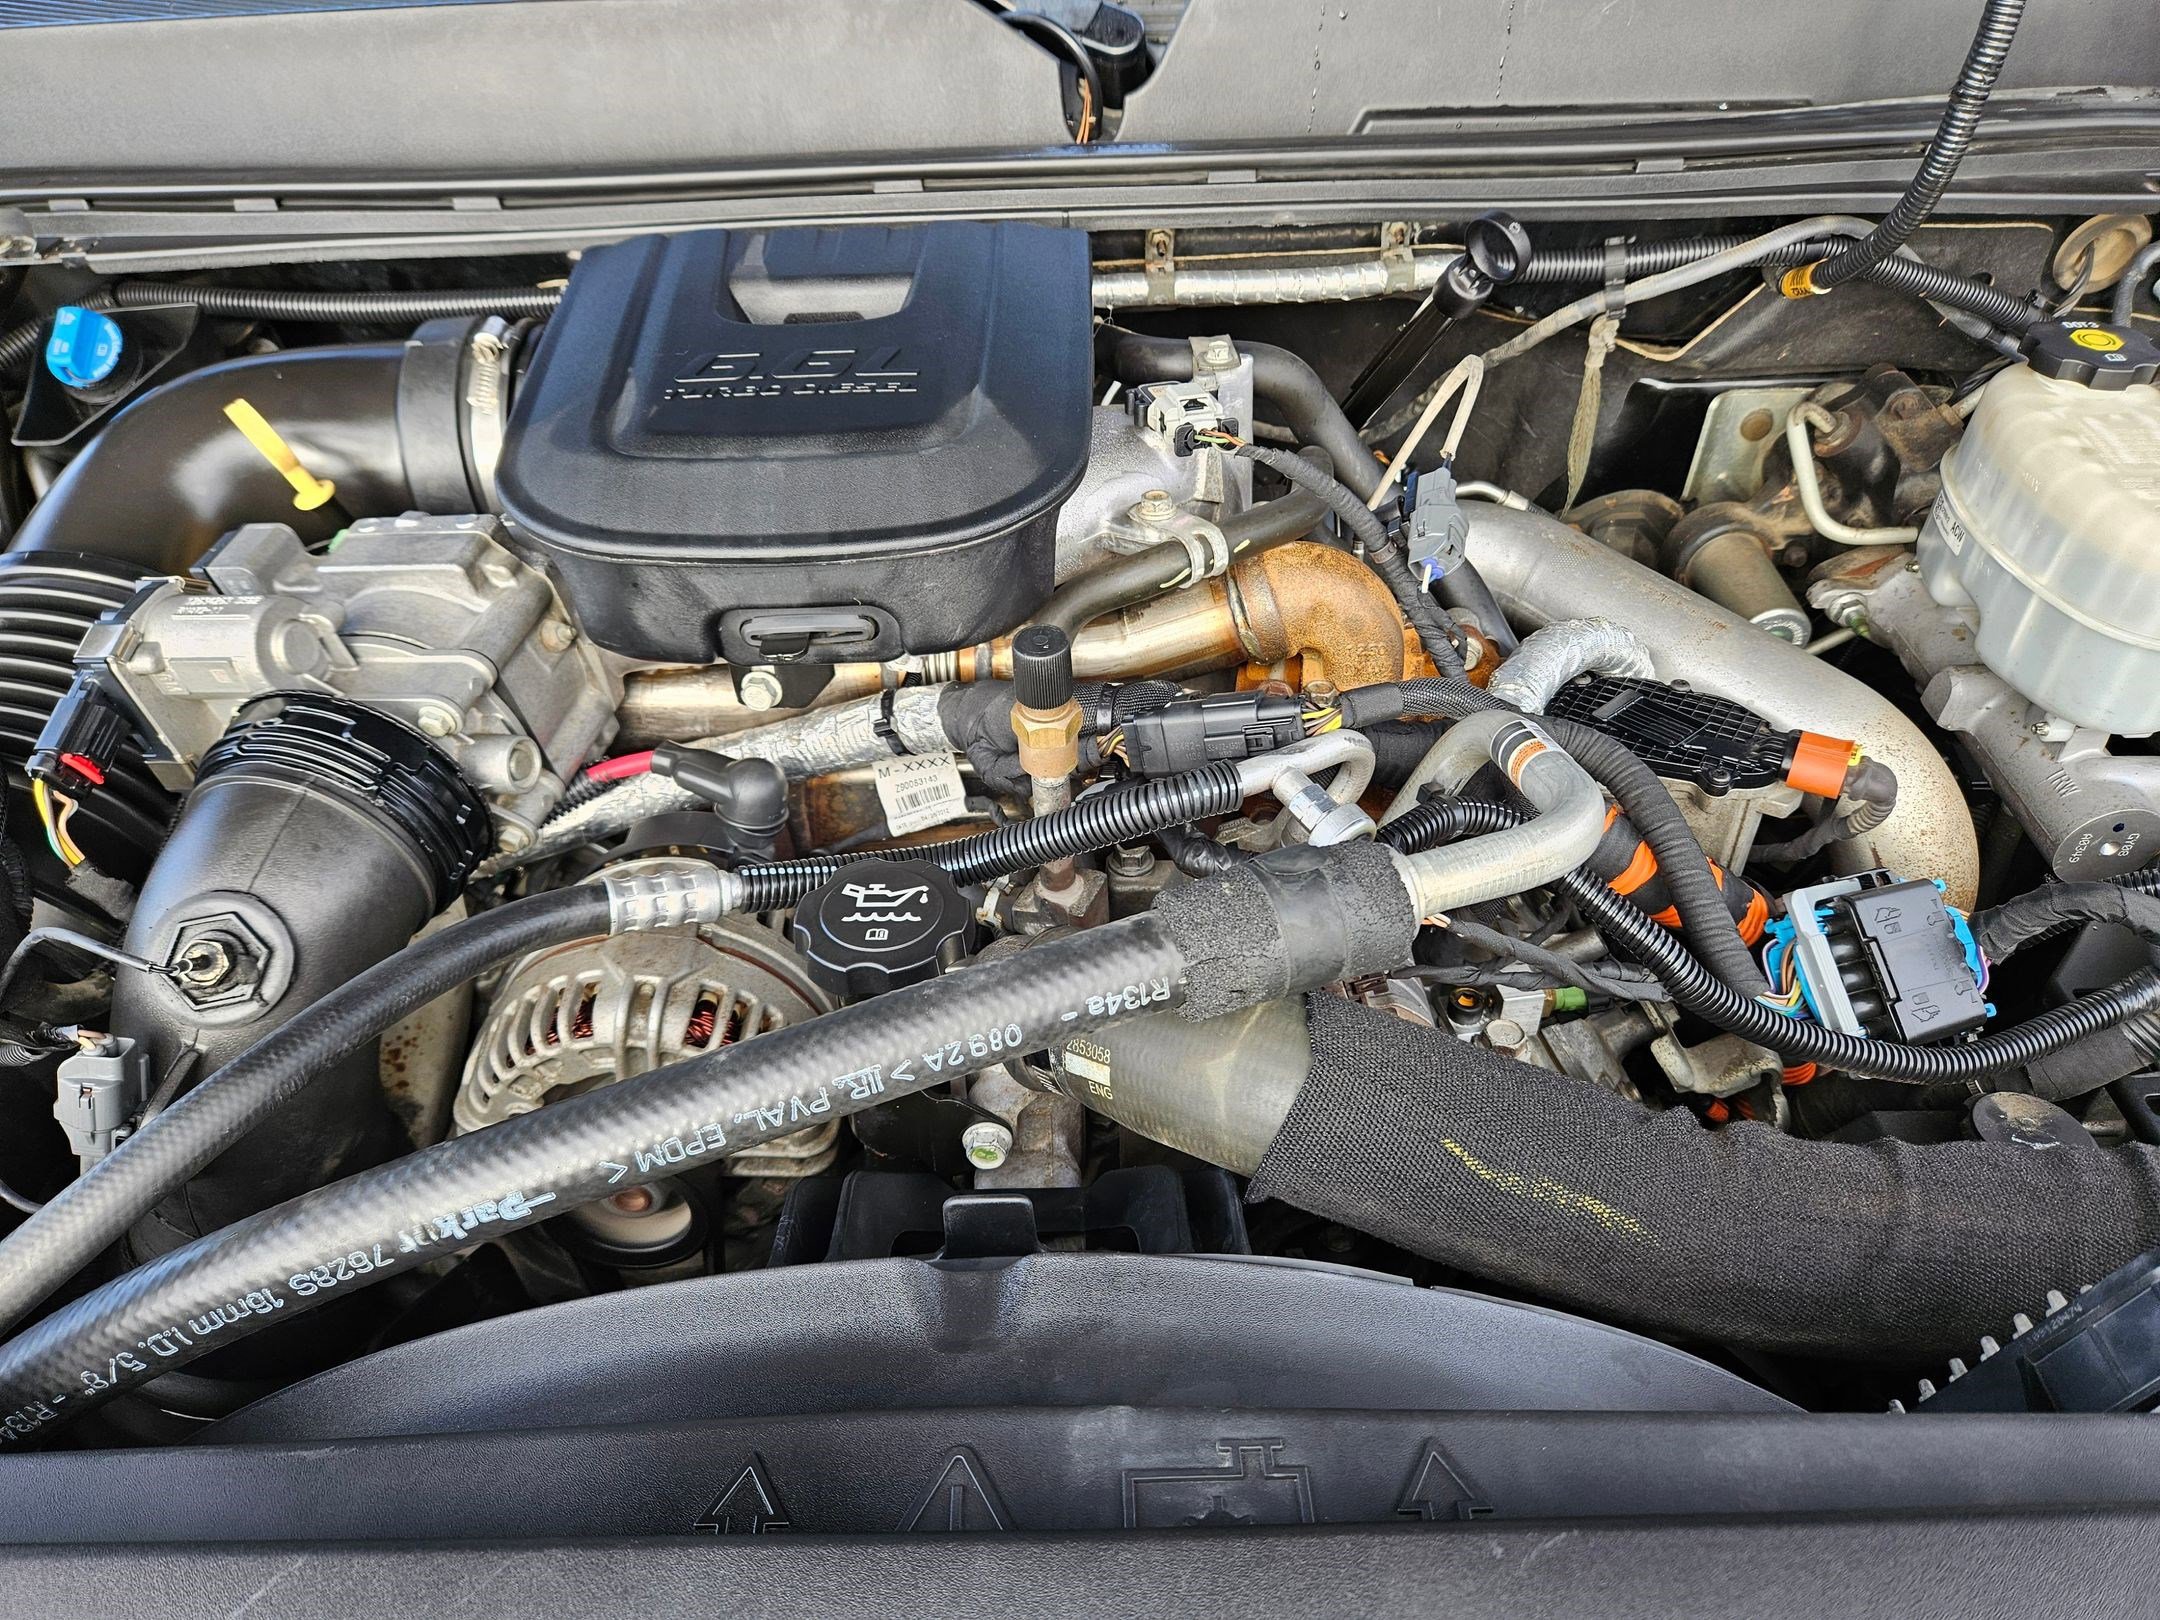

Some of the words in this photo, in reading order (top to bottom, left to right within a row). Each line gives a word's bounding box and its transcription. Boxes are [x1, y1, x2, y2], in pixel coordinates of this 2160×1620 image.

[674, 347, 919, 383] 6.6L
[664, 384, 782, 400] TURBO
[792, 381, 918, 395] DIESEL
[1085, 976, 1171, 1016] R134a
[922, 1023, 1023, 1073] 0892A
[1088, 1080, 1113, 1100] ENG
[634, 1123, 727, 1173] EPDM
[288, 1243, 395, 1297] 7628S
[188, 1287, 284, 1335] 16mm
[0, 1400, 58, 1441] R134
